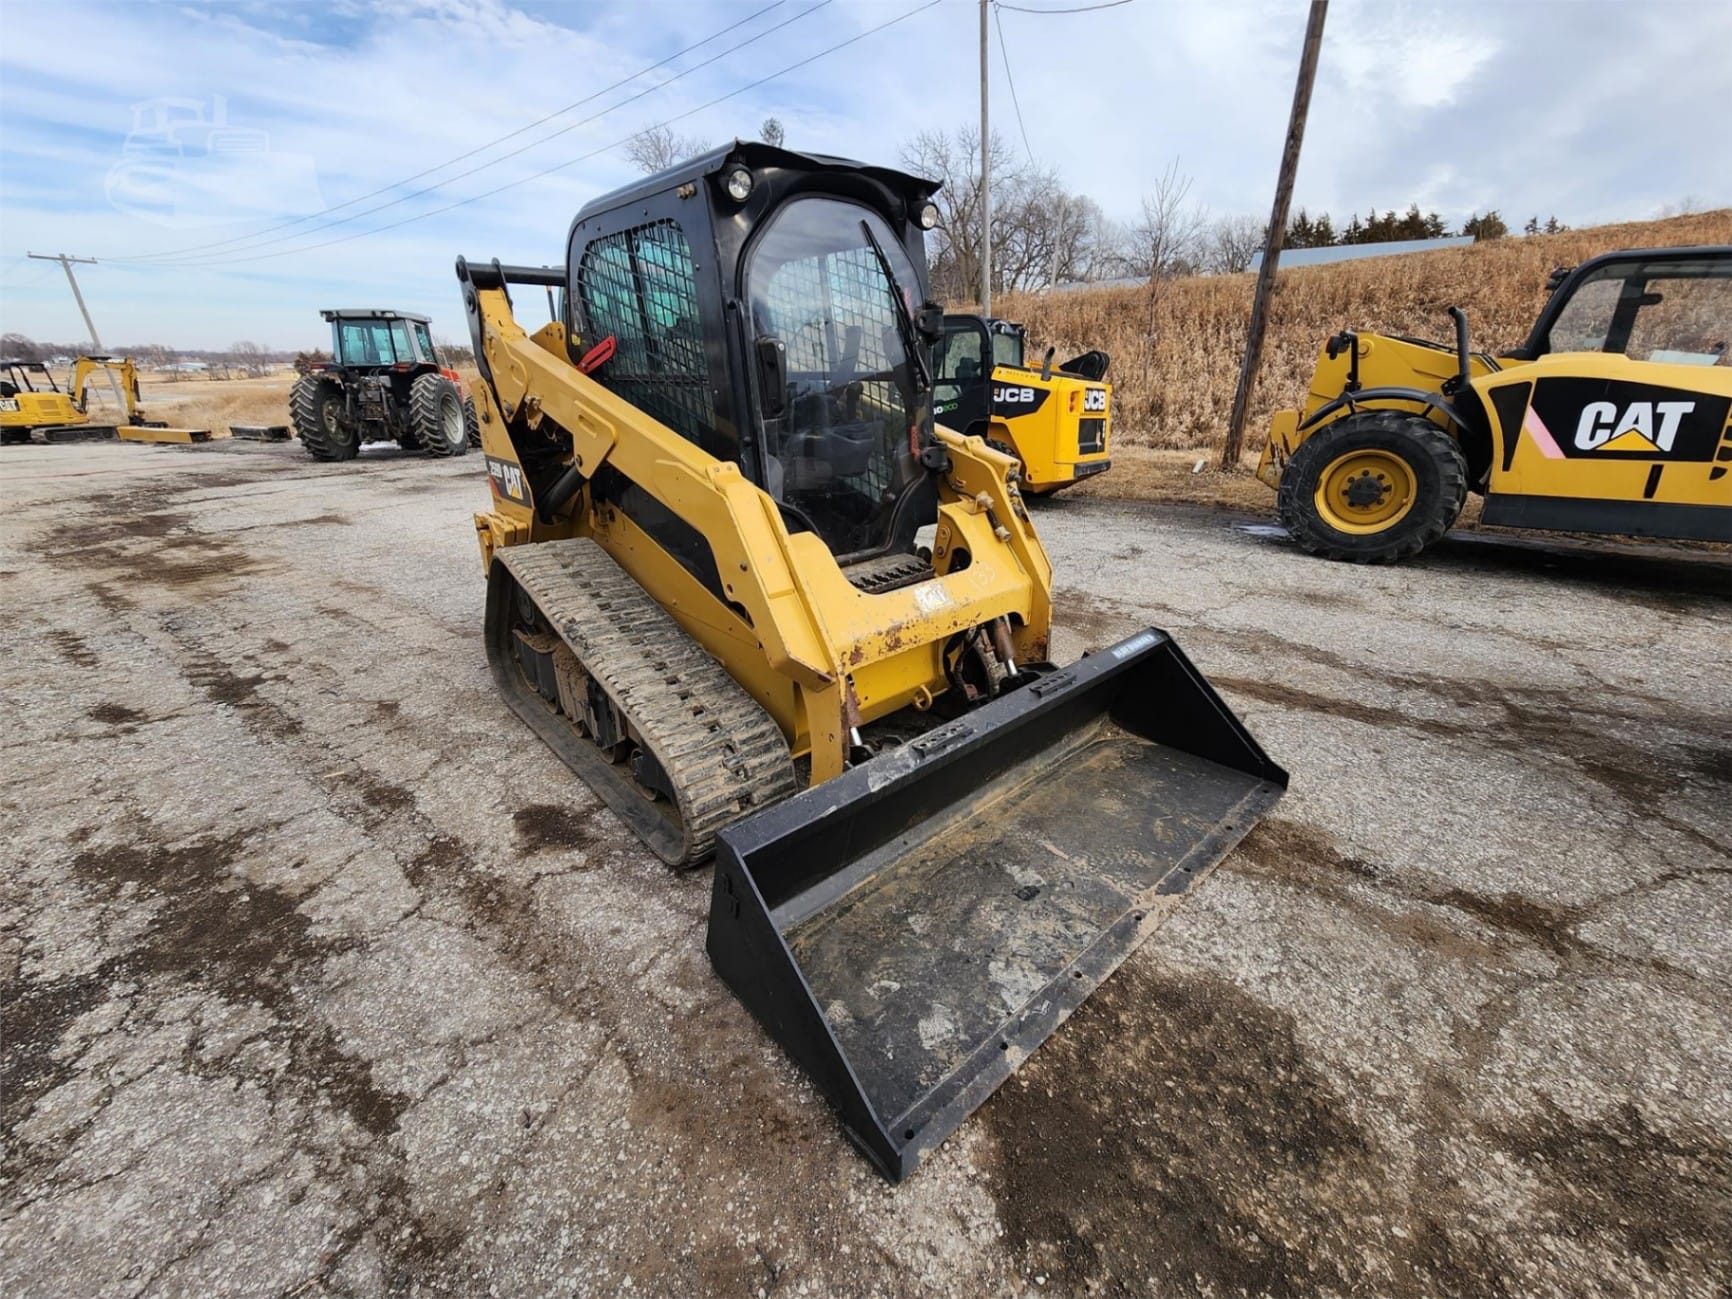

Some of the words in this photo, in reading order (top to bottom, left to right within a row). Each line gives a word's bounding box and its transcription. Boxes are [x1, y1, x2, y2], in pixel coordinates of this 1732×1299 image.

[993, 388, 1034, 402] JCB
[1085, 389, 1105, 410] JCB
[1574, 401, 1696, 452] CAT
[503, 464, 523, 500] CAT
